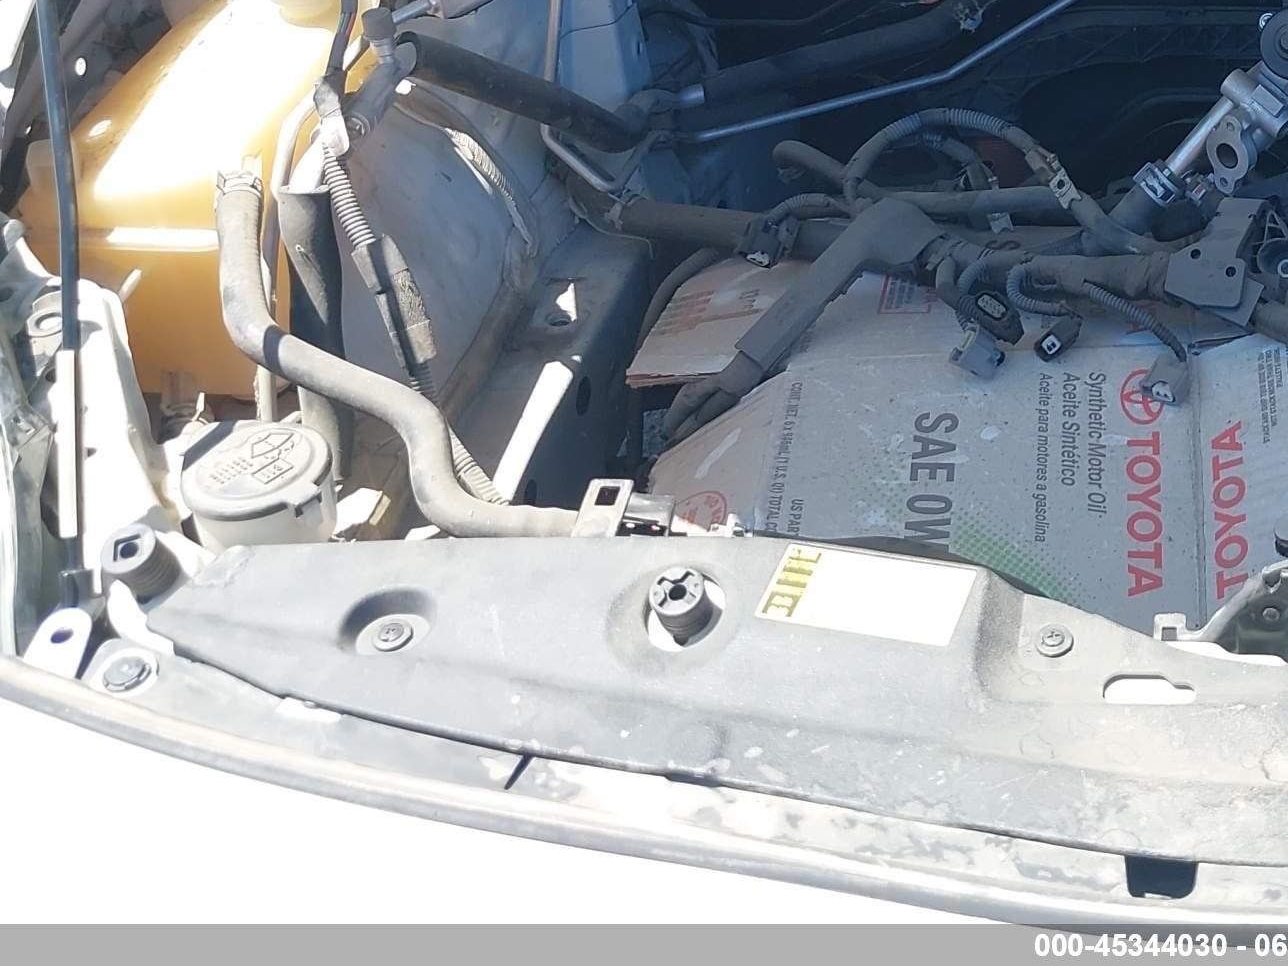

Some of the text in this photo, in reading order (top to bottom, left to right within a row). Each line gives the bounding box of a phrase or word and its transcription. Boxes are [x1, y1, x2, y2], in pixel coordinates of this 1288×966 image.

[1038, 372, 1053, 406] Aceite
[1035, 408, 1049, 433] para
[1061, 372, 1082, 486] Aceite Sintético
[1084, 372, 1108, 514] Synthetic Motor Oil
[909, 412, 960, 482] SAE
[1036, 435, 1049, 481] motores
[766, 494, 783, 520] TOTAL
[790, 498, 805, 511] US
[1032, 493, 1049, 543] gasolina
[1126, 431, 1164, 597] TOYOTA
[1211, 420, 1249, 600] TOYOTA
